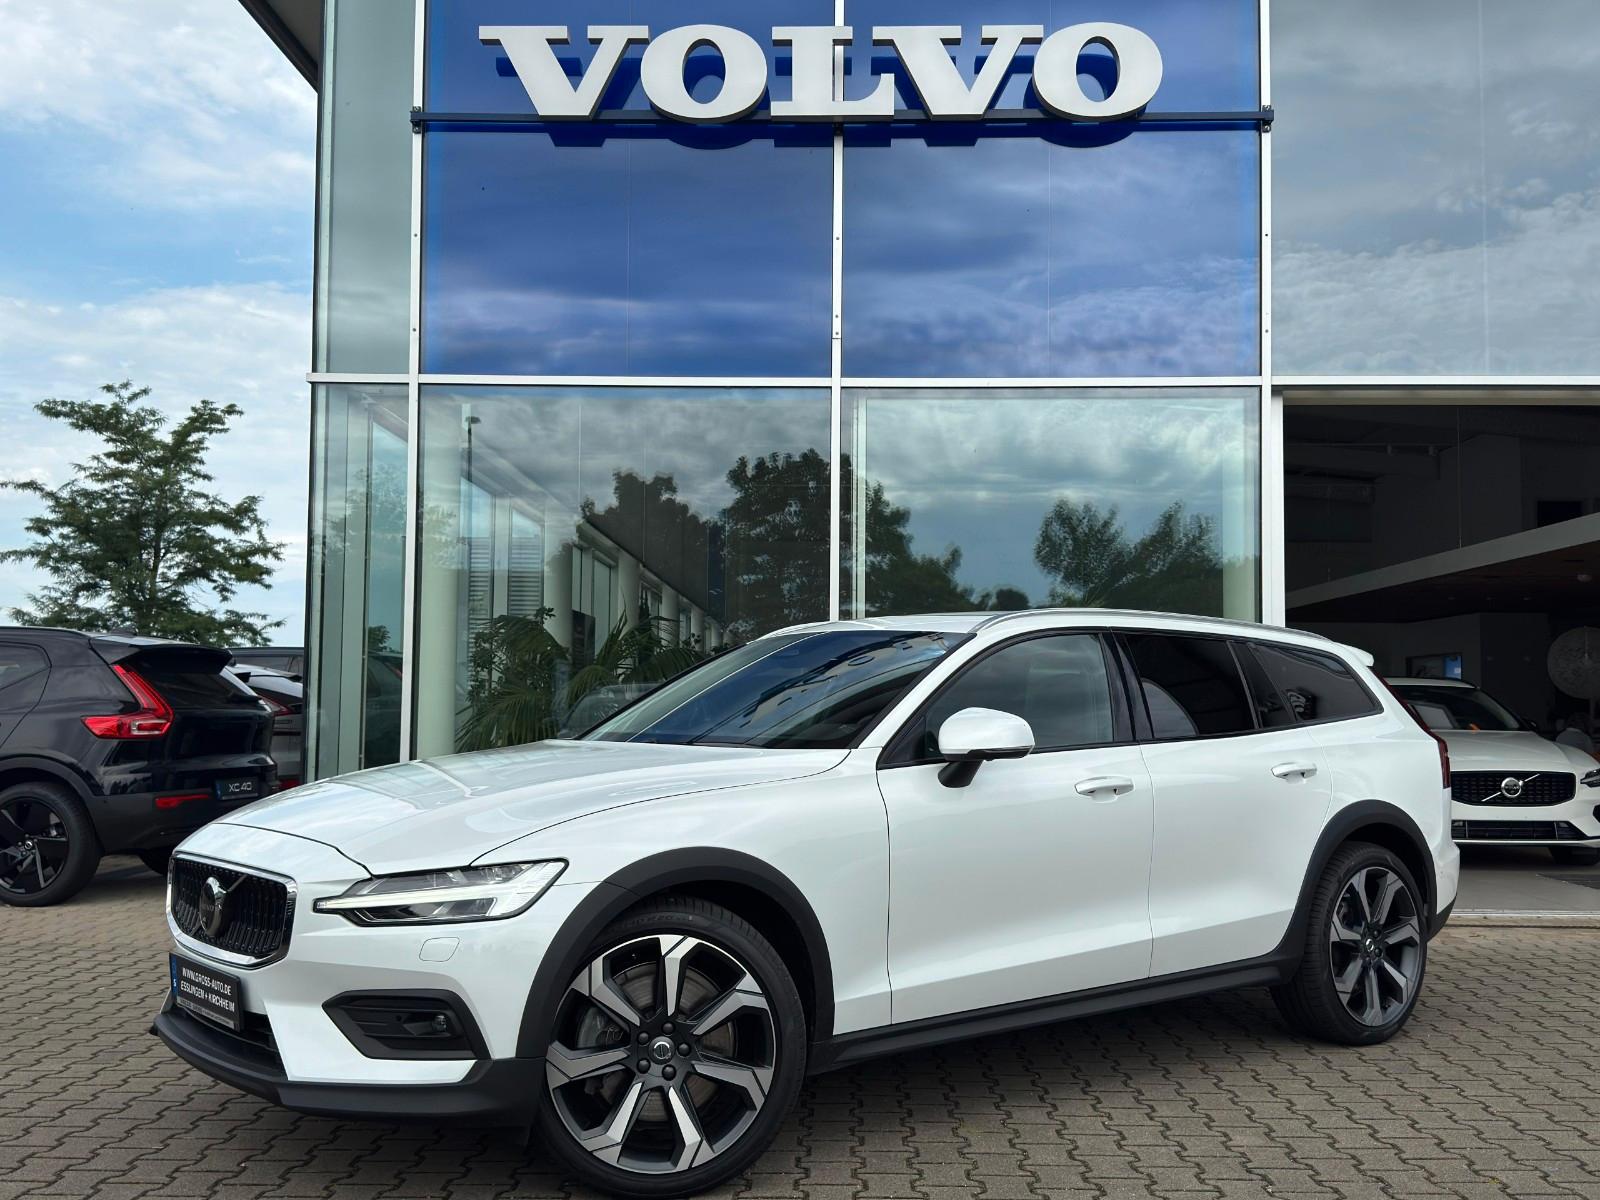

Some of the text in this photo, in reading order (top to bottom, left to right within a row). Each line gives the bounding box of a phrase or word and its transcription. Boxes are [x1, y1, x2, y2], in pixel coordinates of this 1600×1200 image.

[478, 22, 1163, 121] VOLVO
[180, 980, 204, 999] ESSLINGEN
[208, 992, 235, 1012] KIRCHHEIM
